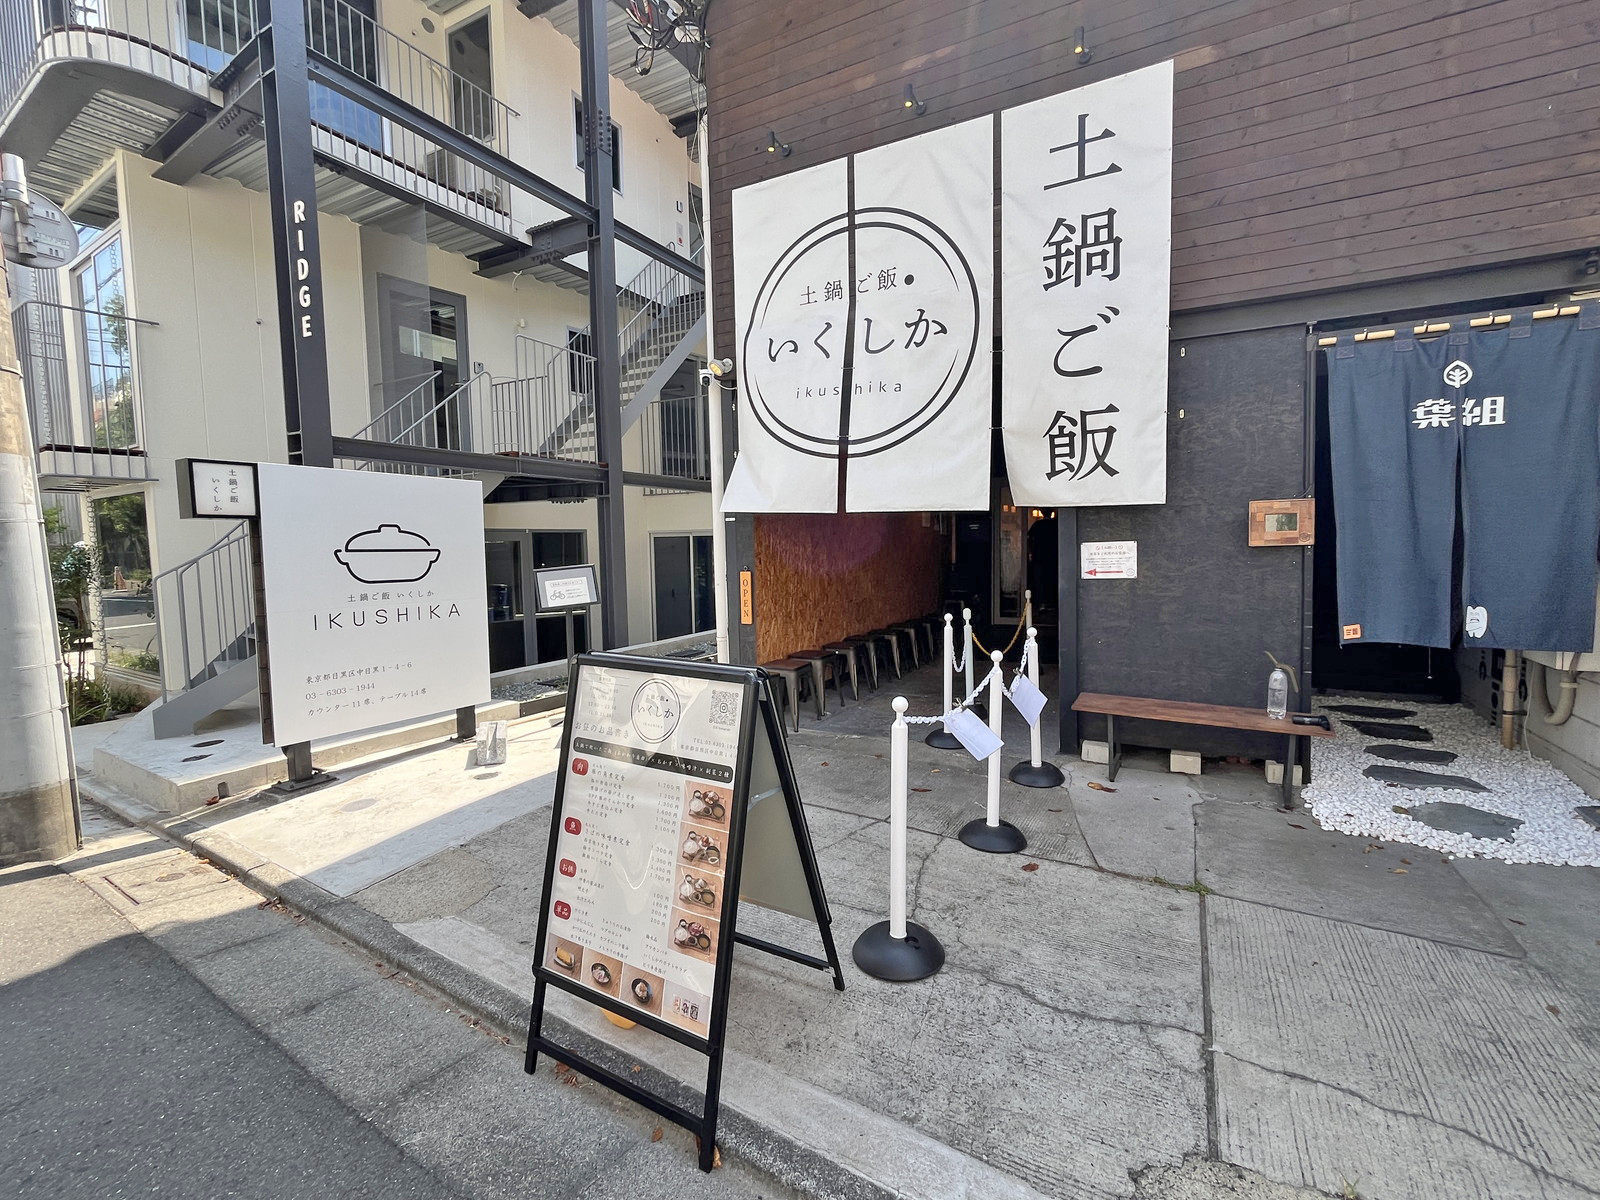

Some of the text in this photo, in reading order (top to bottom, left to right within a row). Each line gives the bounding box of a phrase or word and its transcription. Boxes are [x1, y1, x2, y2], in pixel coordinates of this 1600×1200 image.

[293, 200, 313, 338] RIDGE
[799, 266, 897, 306] 土鍋ご飯
[1042, 113, 1123, 481] 土鍋ご飯
[768, 308, 948, 362] いくしか
[796, 380, 903, 399] ikushika
[1411, 396, 1506, 429] 葉組
[211, 477, 223, 512] いくしか
[228, 469, 239, 503] 土鍋ご飯
[347, 589, 434, 602] 土鍋ご飯 いくしか
[313, 603, 461, 631] IKUSHIKA
[637, 704, 674, 719] いくしか
